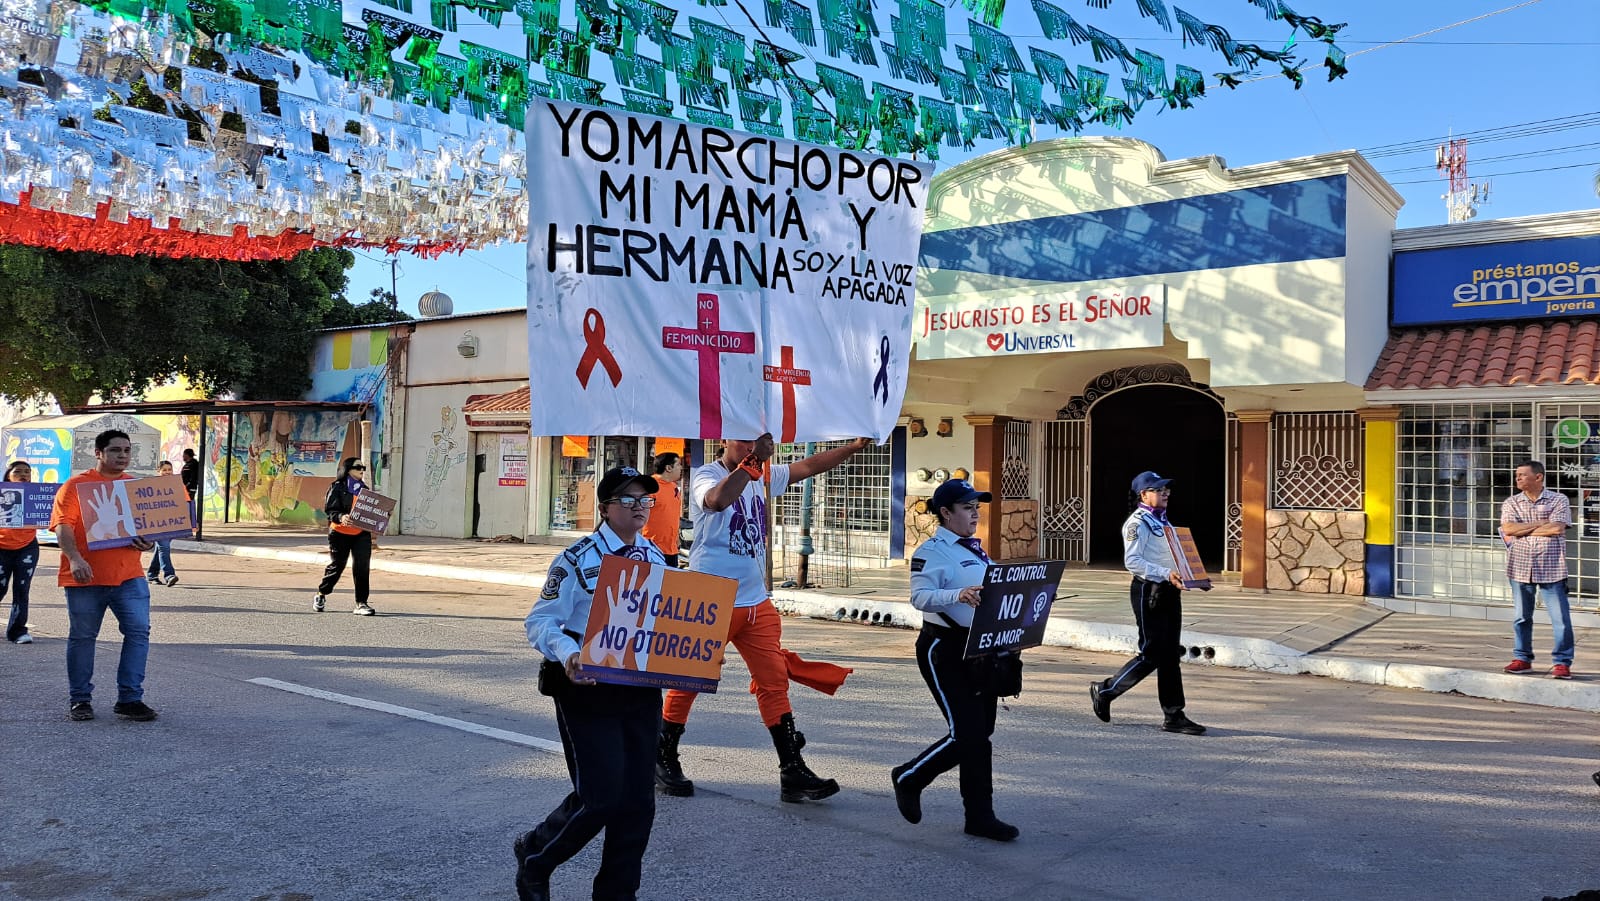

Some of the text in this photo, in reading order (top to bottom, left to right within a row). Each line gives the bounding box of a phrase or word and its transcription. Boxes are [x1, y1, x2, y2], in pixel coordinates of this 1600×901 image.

[628, 116, 831, 191] MARCHO
[839, 152, 922, 208] POR
[600, 170, 651, 223] MI
[848, 202, 876, 250] Y
[548, 223, 794, 293] HERMANA
[792, 250, 913, 286] SOY LA VOZ
[1453, 265, 1600, 305] empeñ
[1472, 261, 1579, 284] préstamos
[821, 275, 907, 307] APAGADA
[699, 300, 713, 310] NO
[923, 293, 1152, 338] JESUCRISTO ES EL SEÑOR
[666, 332, 741, 348] FEMINICIDIO
[1005, 331, 1076, 352] UNIVERSAL
[164, 487, 174, 496] LA
[34, 502, 53, 510] VIVA
[134, 513, 147, 530] SÍ
[150, 520, 155, 528] A
[157, 519, 167, 527] LA
[1006, 564, 1047, 583] CONTROL
[650, 593, 718, 626] CALLAS
[998, 593, 1024, 621] NO
[600, 624, 628, 651] NO
[978, 632, 993, 649] ES
